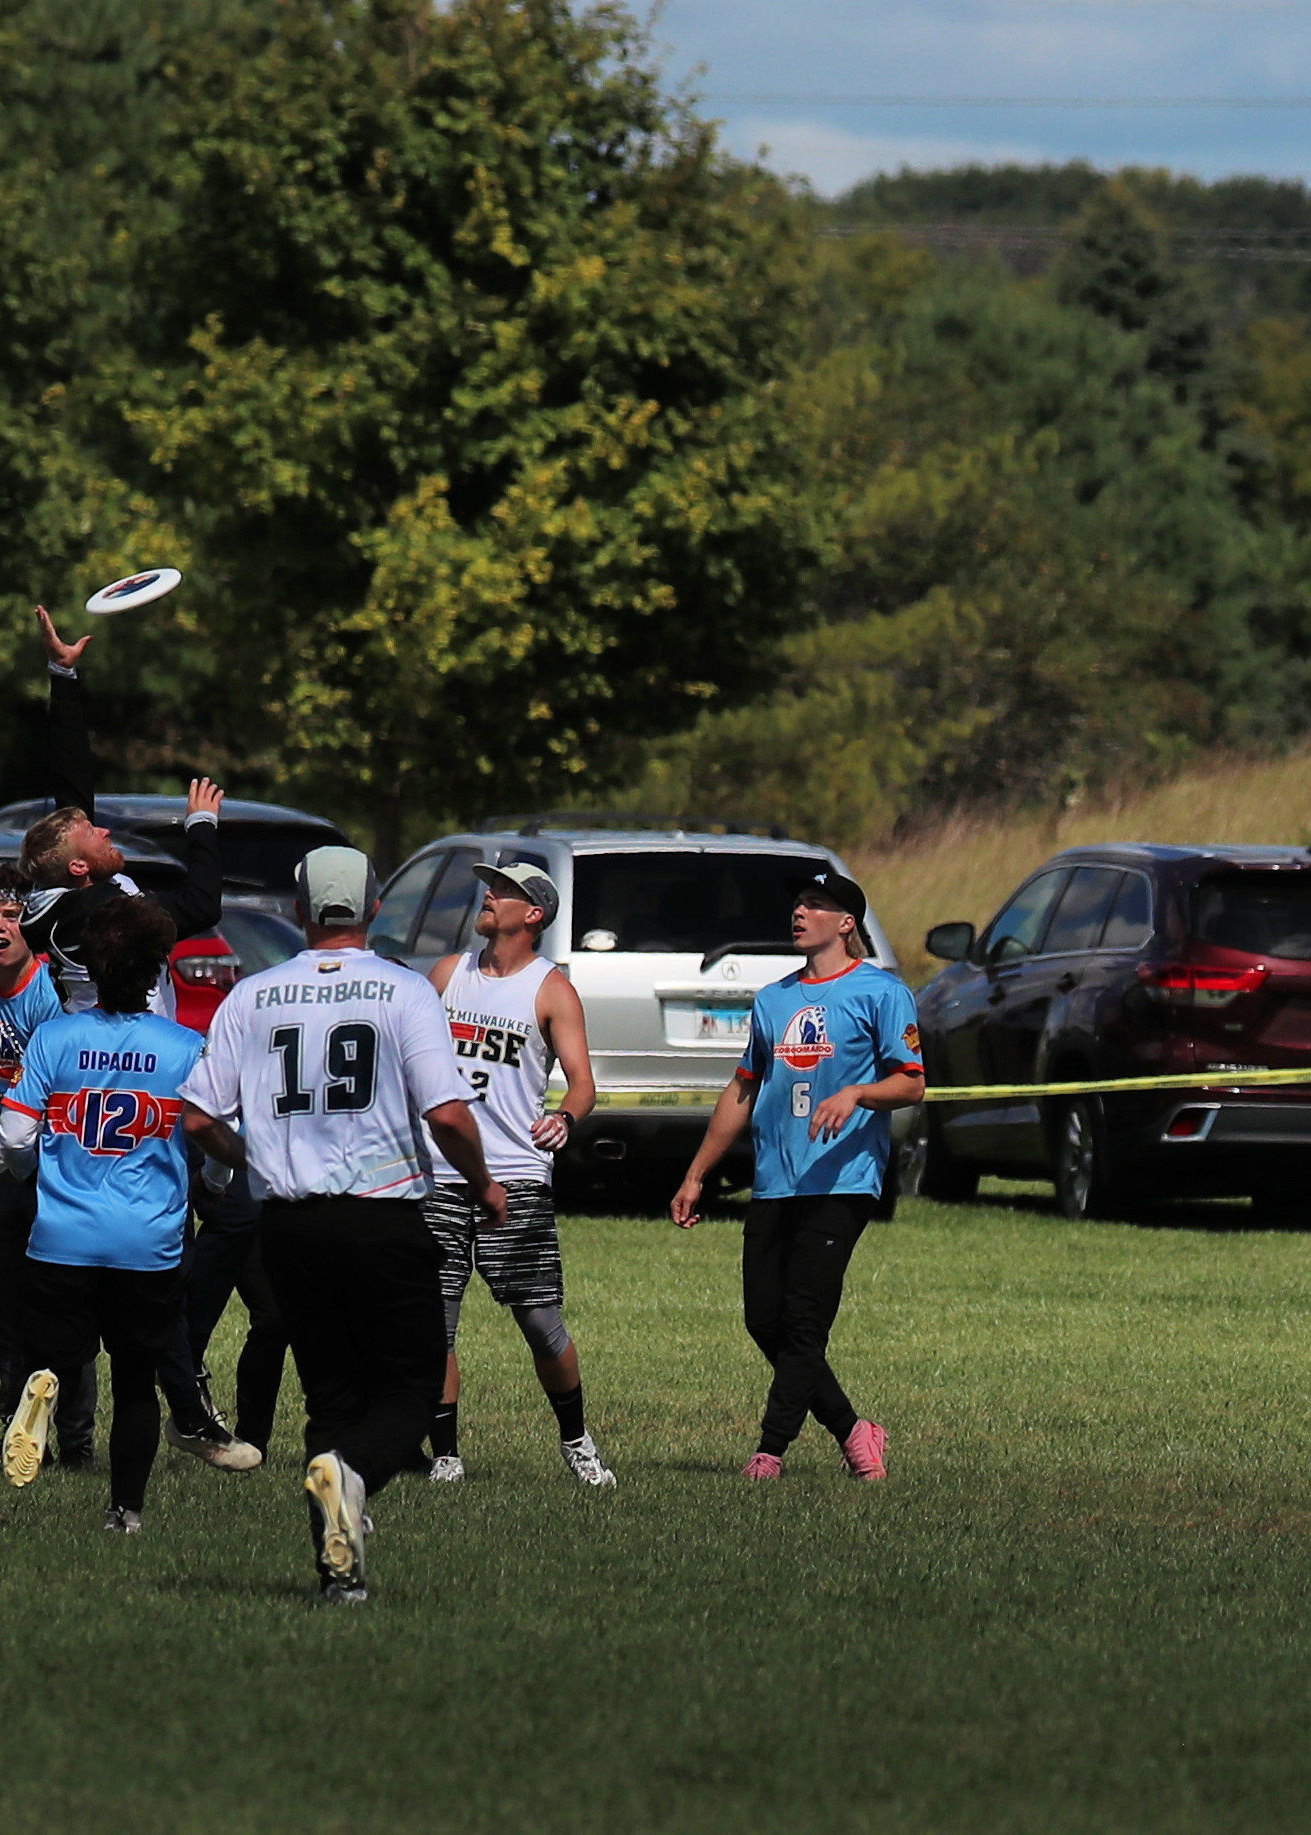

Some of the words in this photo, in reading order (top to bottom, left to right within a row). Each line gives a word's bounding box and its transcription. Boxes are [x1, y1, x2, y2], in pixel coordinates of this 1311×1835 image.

[255, 980, 397, 1010] FAUERBACH
[456, 1010, 533, 1036] MILWAUKEE
[78, 1049, 158, 1074] DIPAOLO
[454, 1028, 527, 1069] USE
[269, 1020, 379, 1120] 19
[457, 1067, 490, 1102] 2
[792, 1082, 812, 1118] 6
[80, 1089, 139, 1151] 12
